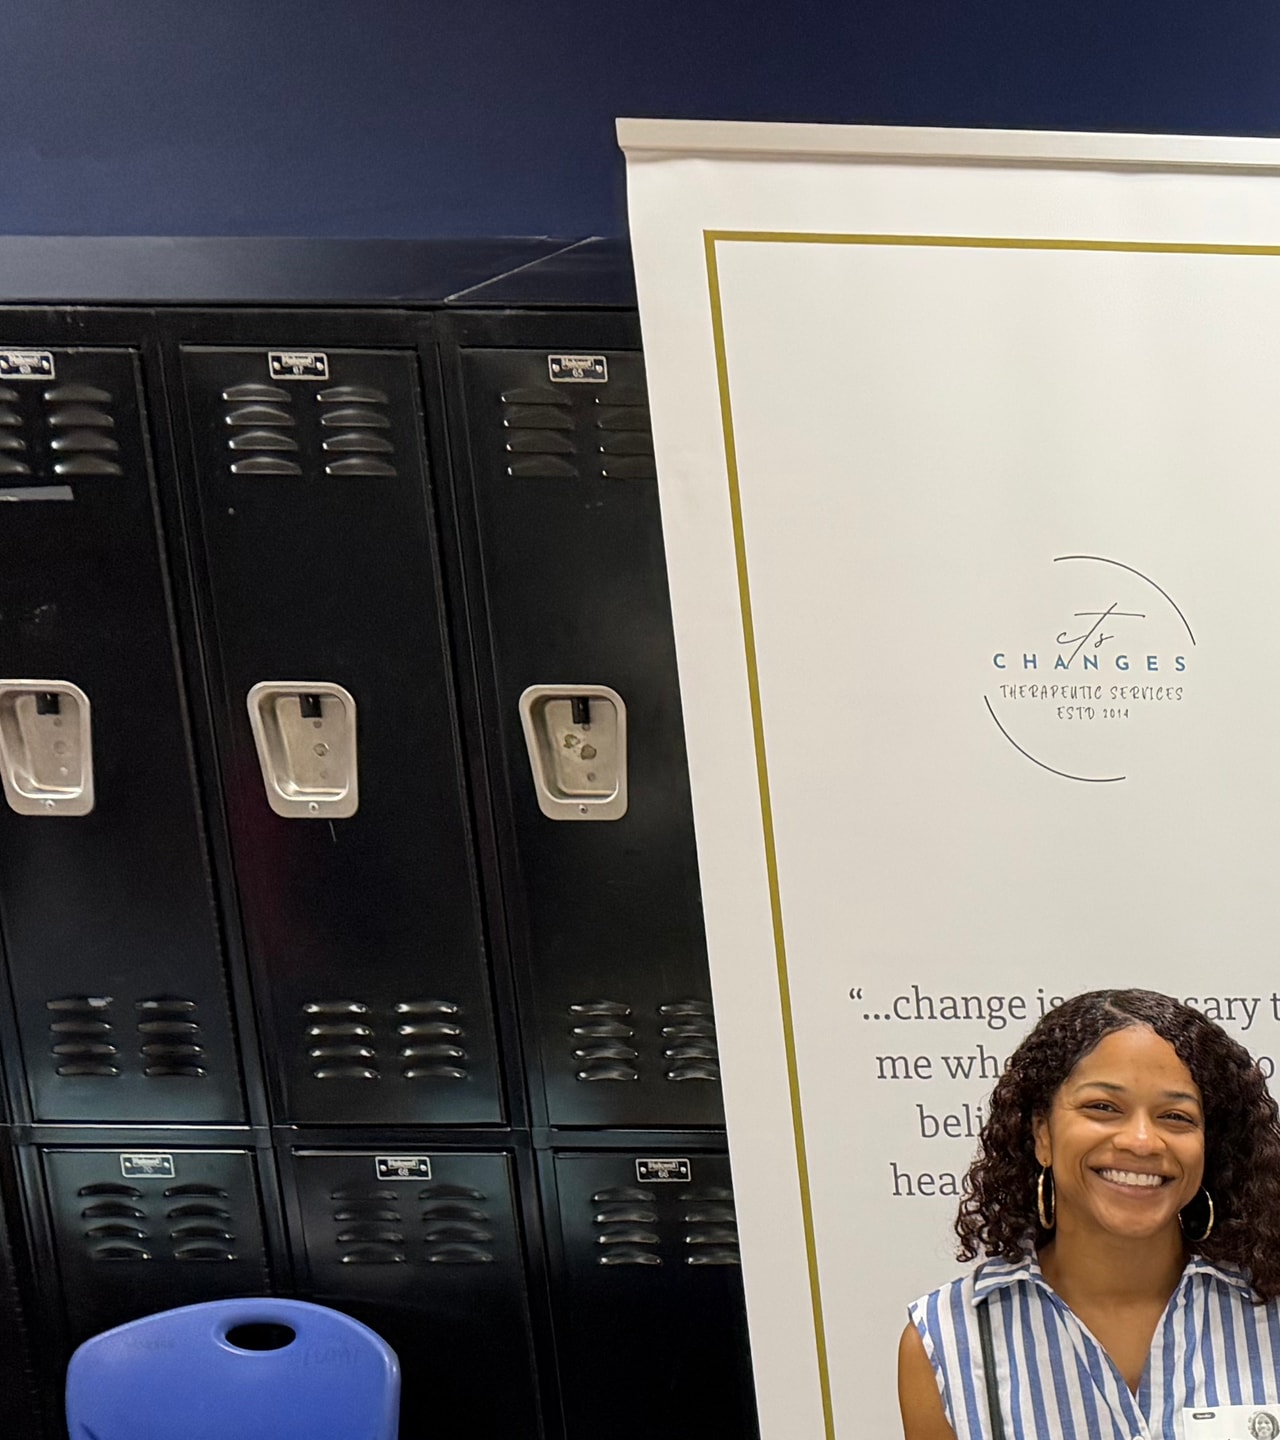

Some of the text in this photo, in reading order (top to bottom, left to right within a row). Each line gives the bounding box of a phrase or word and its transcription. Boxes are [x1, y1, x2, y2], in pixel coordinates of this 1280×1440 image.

[993, 653, 1186, 672] CHANGES
[1000, 684, 1183, 701] THERAPEUTIC SERVICES
[1057, 706, 1129, 720] ESTD 2014
[876, 1055, 932, 1080] me
